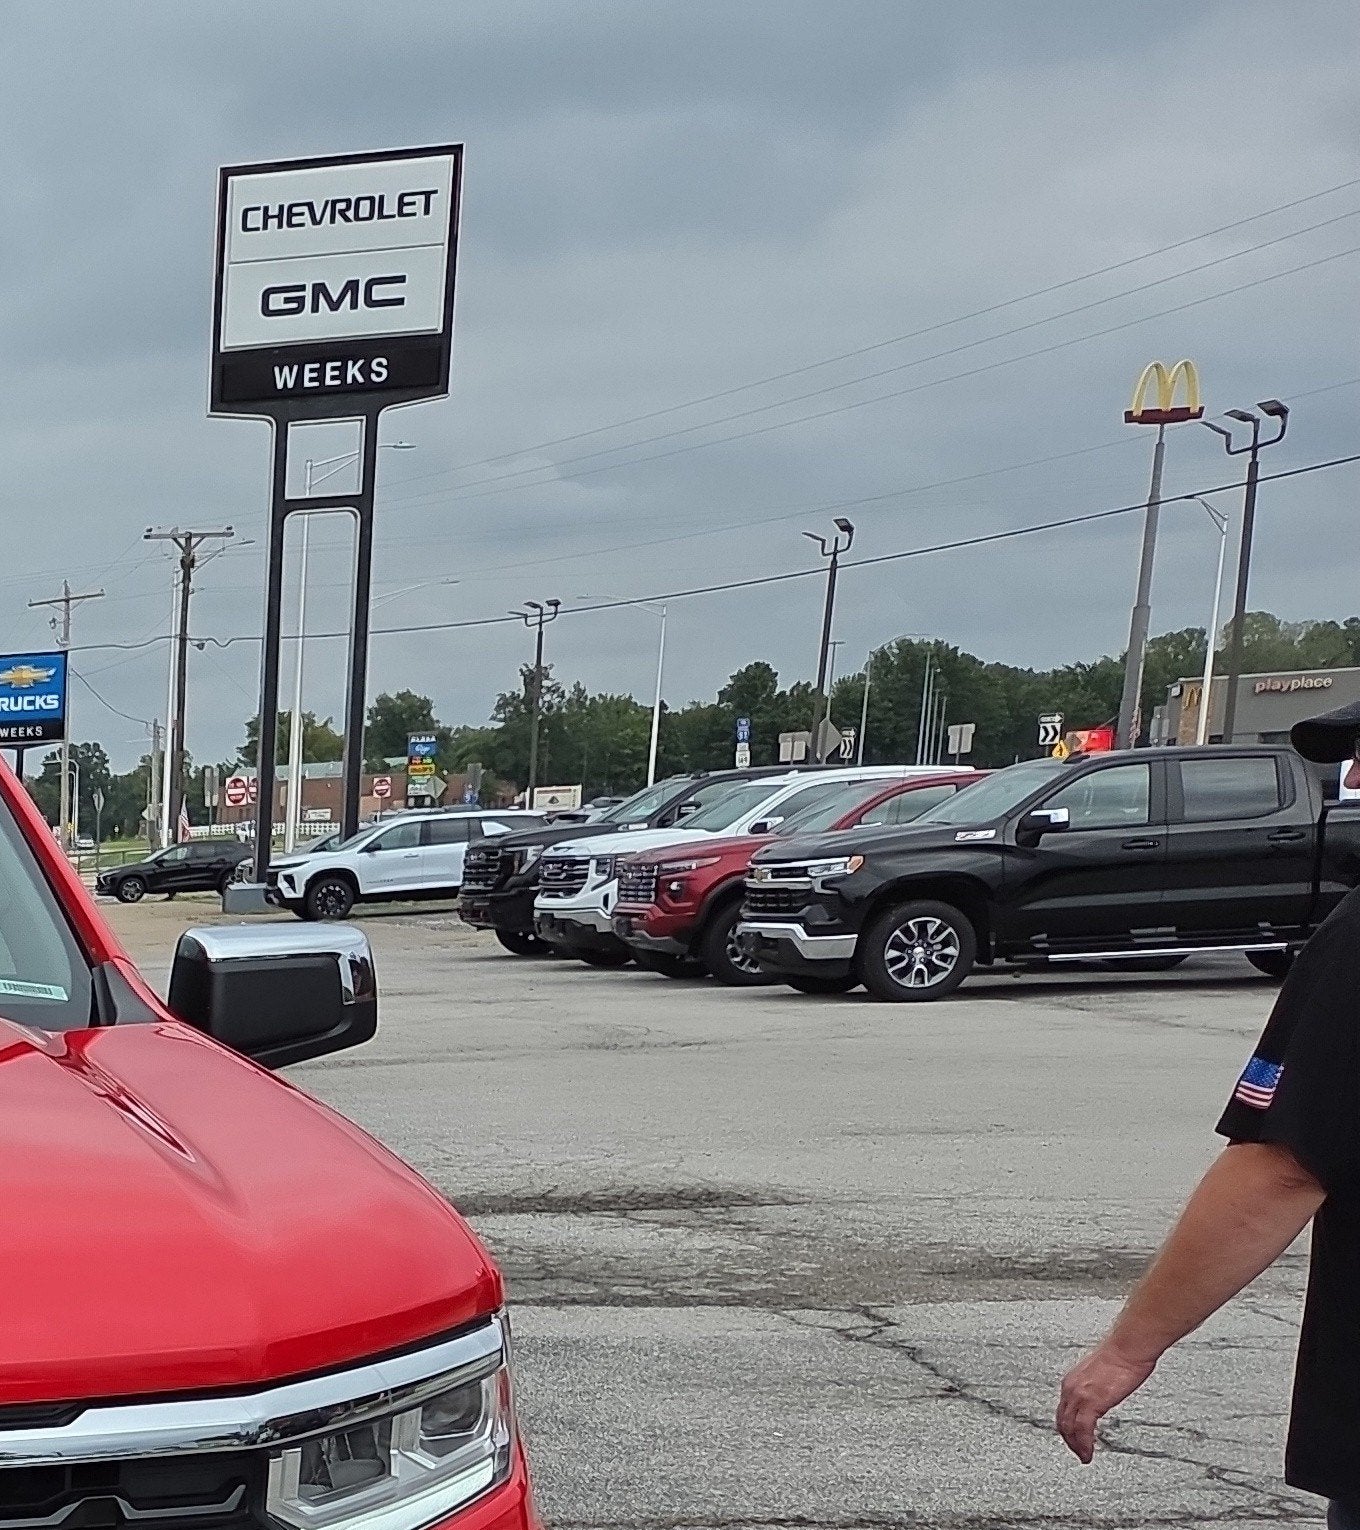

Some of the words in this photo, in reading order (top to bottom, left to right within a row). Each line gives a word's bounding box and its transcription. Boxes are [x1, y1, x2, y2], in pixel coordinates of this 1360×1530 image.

[241, 189, 438, 232] CHEVROLET
[260, 274, 407, 317] GMC
[274, 357, 389, 389] WEEKS
[1254, 676, 1333, 694] playplace
[0, 725, 43, 738] WEEKS
